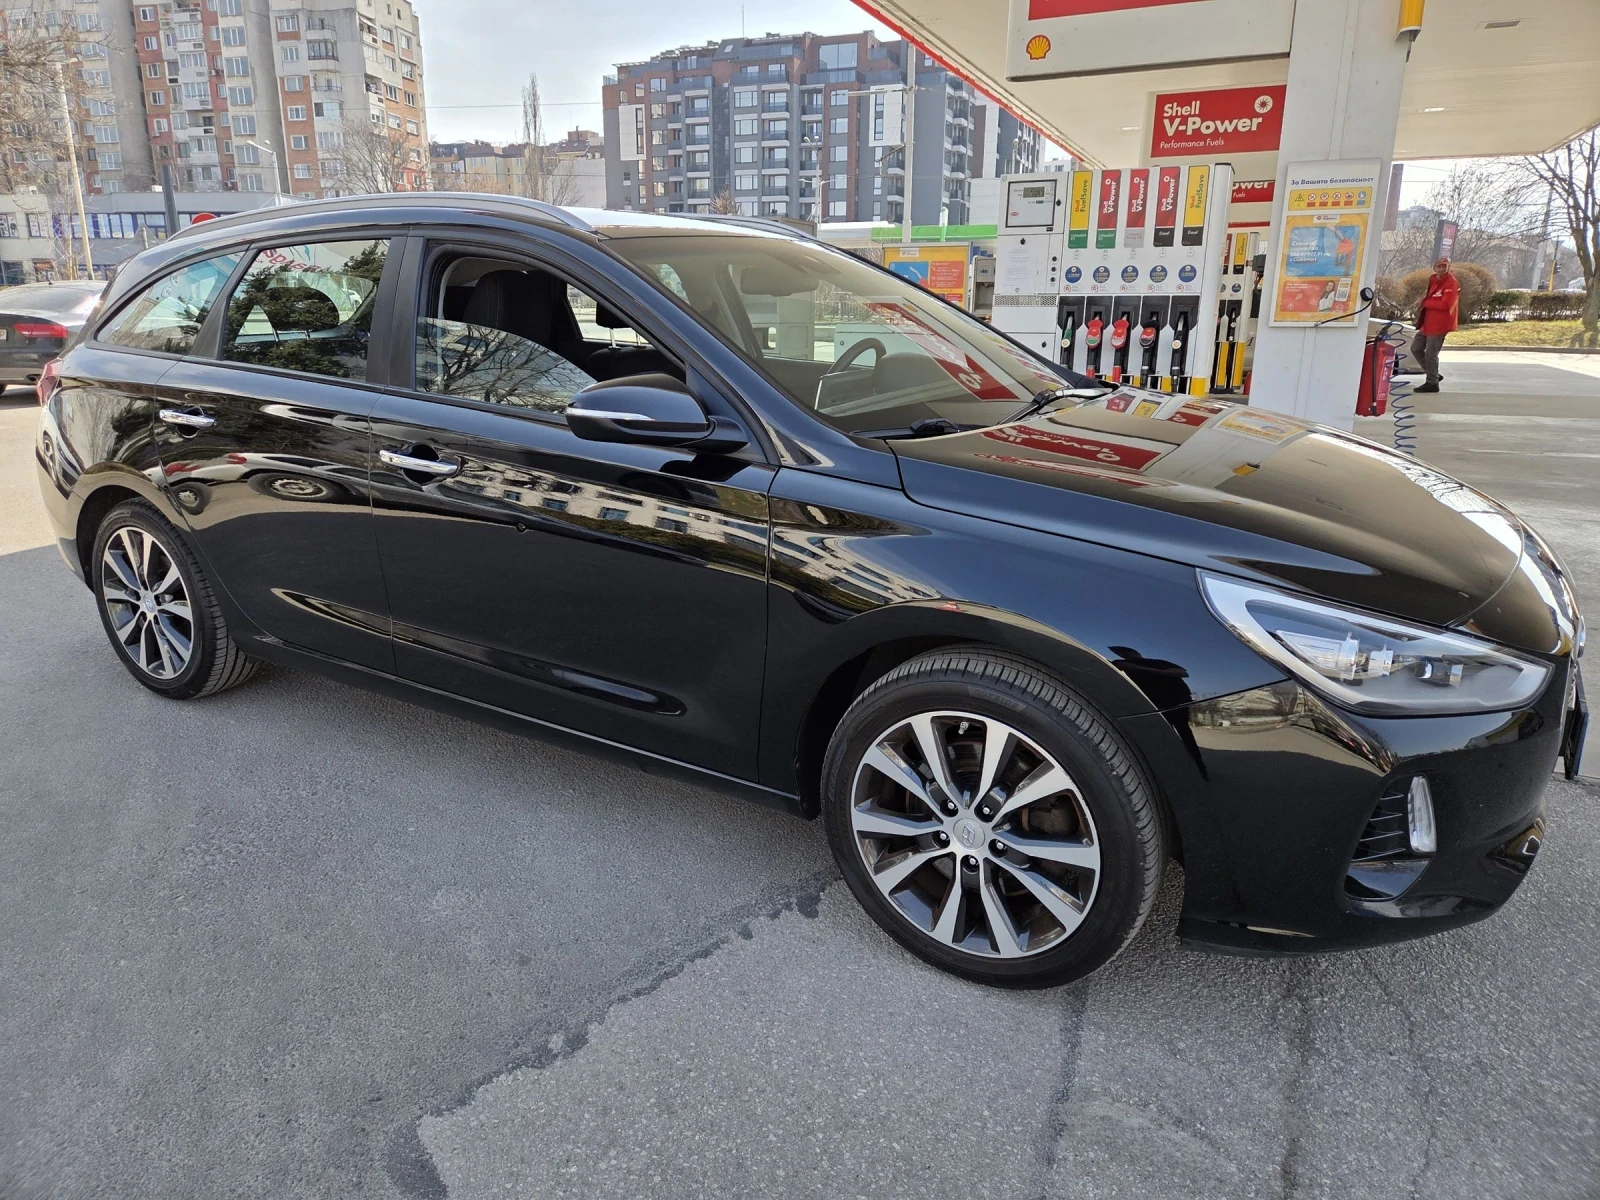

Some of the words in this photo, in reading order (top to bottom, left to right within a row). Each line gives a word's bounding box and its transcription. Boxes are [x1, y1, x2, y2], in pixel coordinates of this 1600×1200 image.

[1163, 101, 1200, 117] Shell
[1163, 117, 1262, 136] V-Power
[1160, 139, 1204, 149] Performance
[1206, 137, 1224, 146] Fuels
[1080, 179, 1088, 212] FuelSave
[1108, 181, 1117, 213] V-Power
[1136, 179, 1145, 212] V-Power
[1166, 178, 1175, 211] V-Power
[1195, 174, 1204, 208] FuelSave
